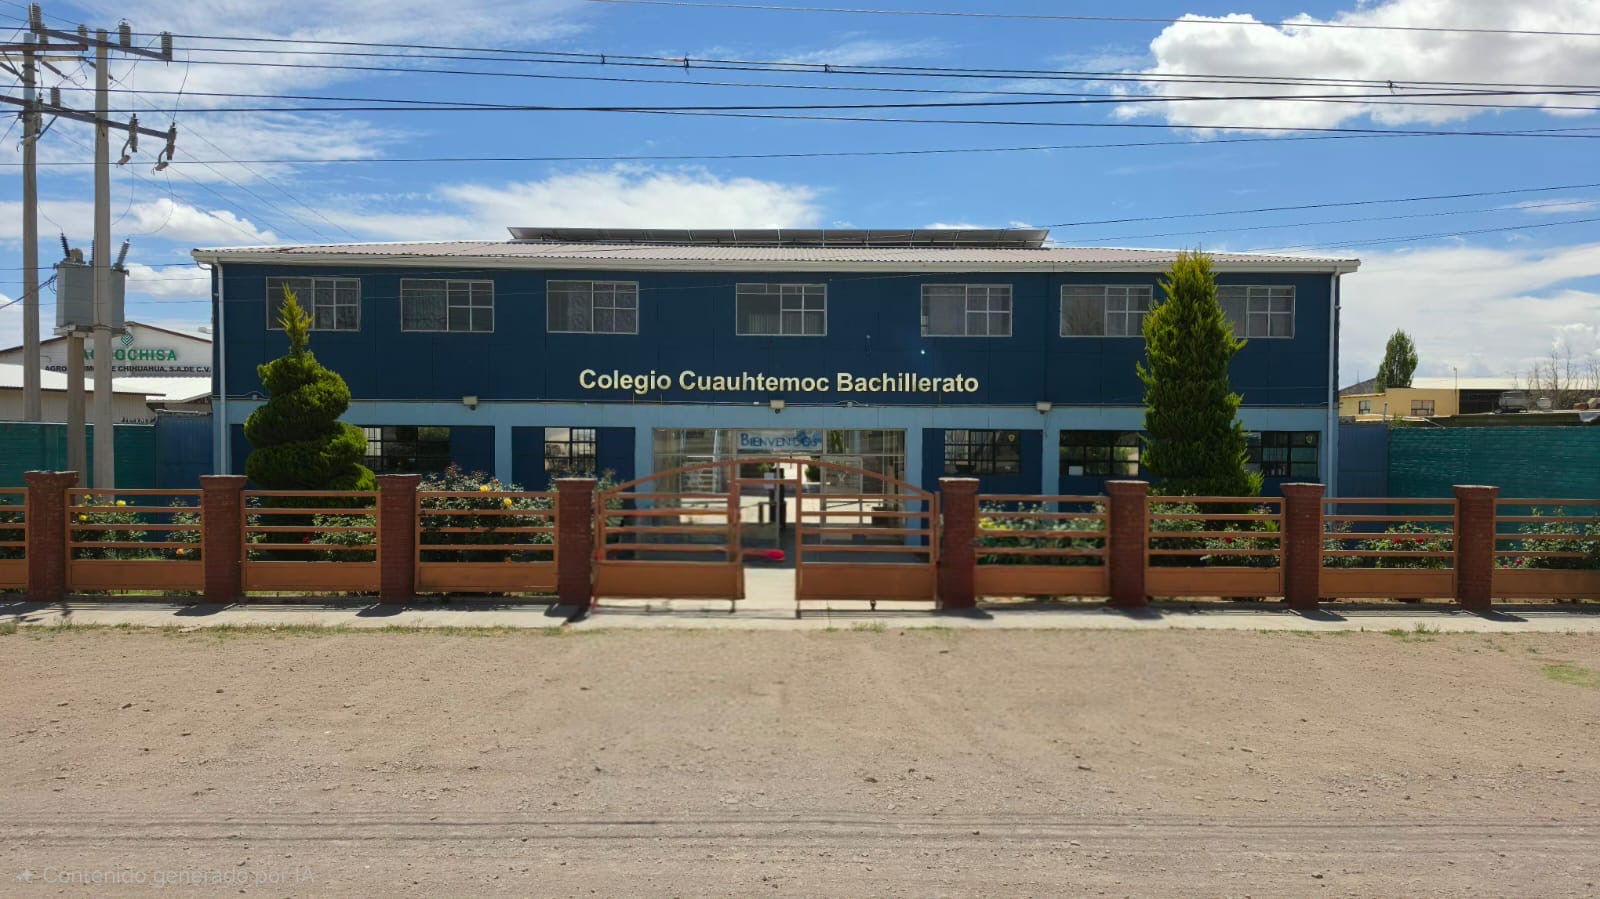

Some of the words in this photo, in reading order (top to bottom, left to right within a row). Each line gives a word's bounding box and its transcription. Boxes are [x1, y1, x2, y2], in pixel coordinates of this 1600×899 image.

[84, 349, 177, 361] AOCHISA
[579, 369, 672, 395] Colegio
[679, 370, 829, 393] Cuauhtemoc
[837, 372, 979, 393] Bachillerato
